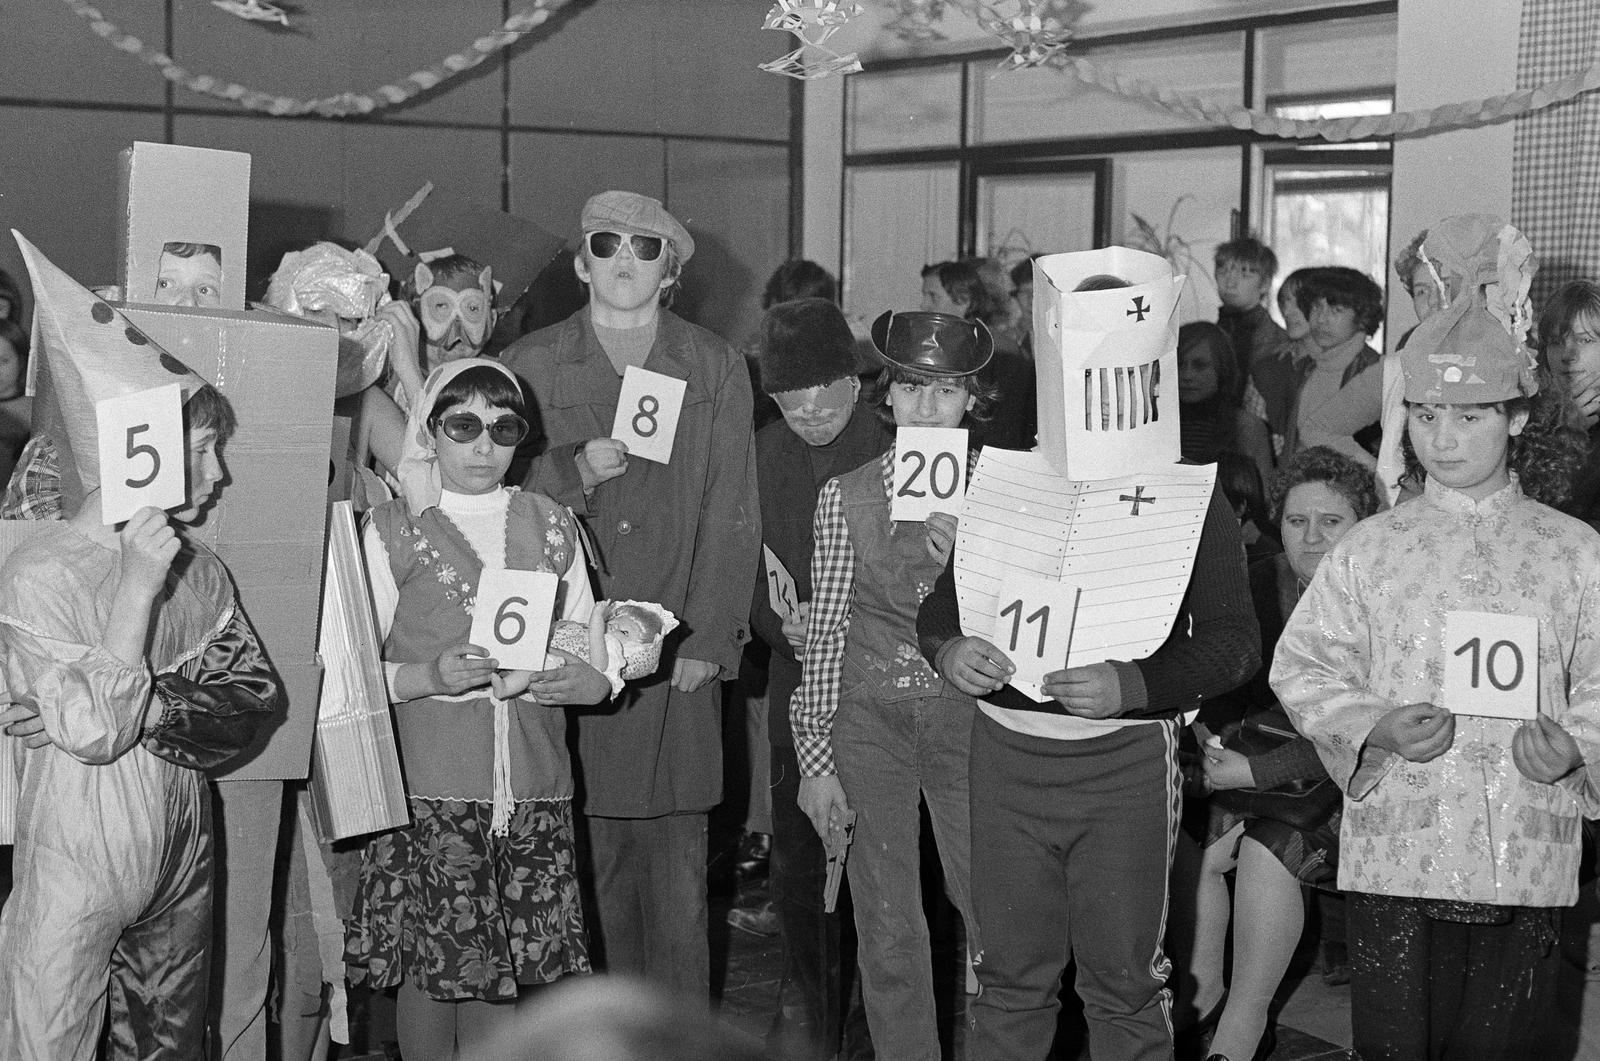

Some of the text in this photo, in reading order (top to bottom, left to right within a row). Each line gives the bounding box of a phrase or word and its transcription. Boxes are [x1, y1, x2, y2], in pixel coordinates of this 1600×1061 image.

[631, 395, 659, 438] 8
[125, 423, 161, 489] 5
[896, 450, 960, 500] 20
[769, 569, 795, 616] 14
[493, 596, 529, 646] 6
[999, 599, 1050, 658] 11
[1453, 637, 1524, 692] 10
